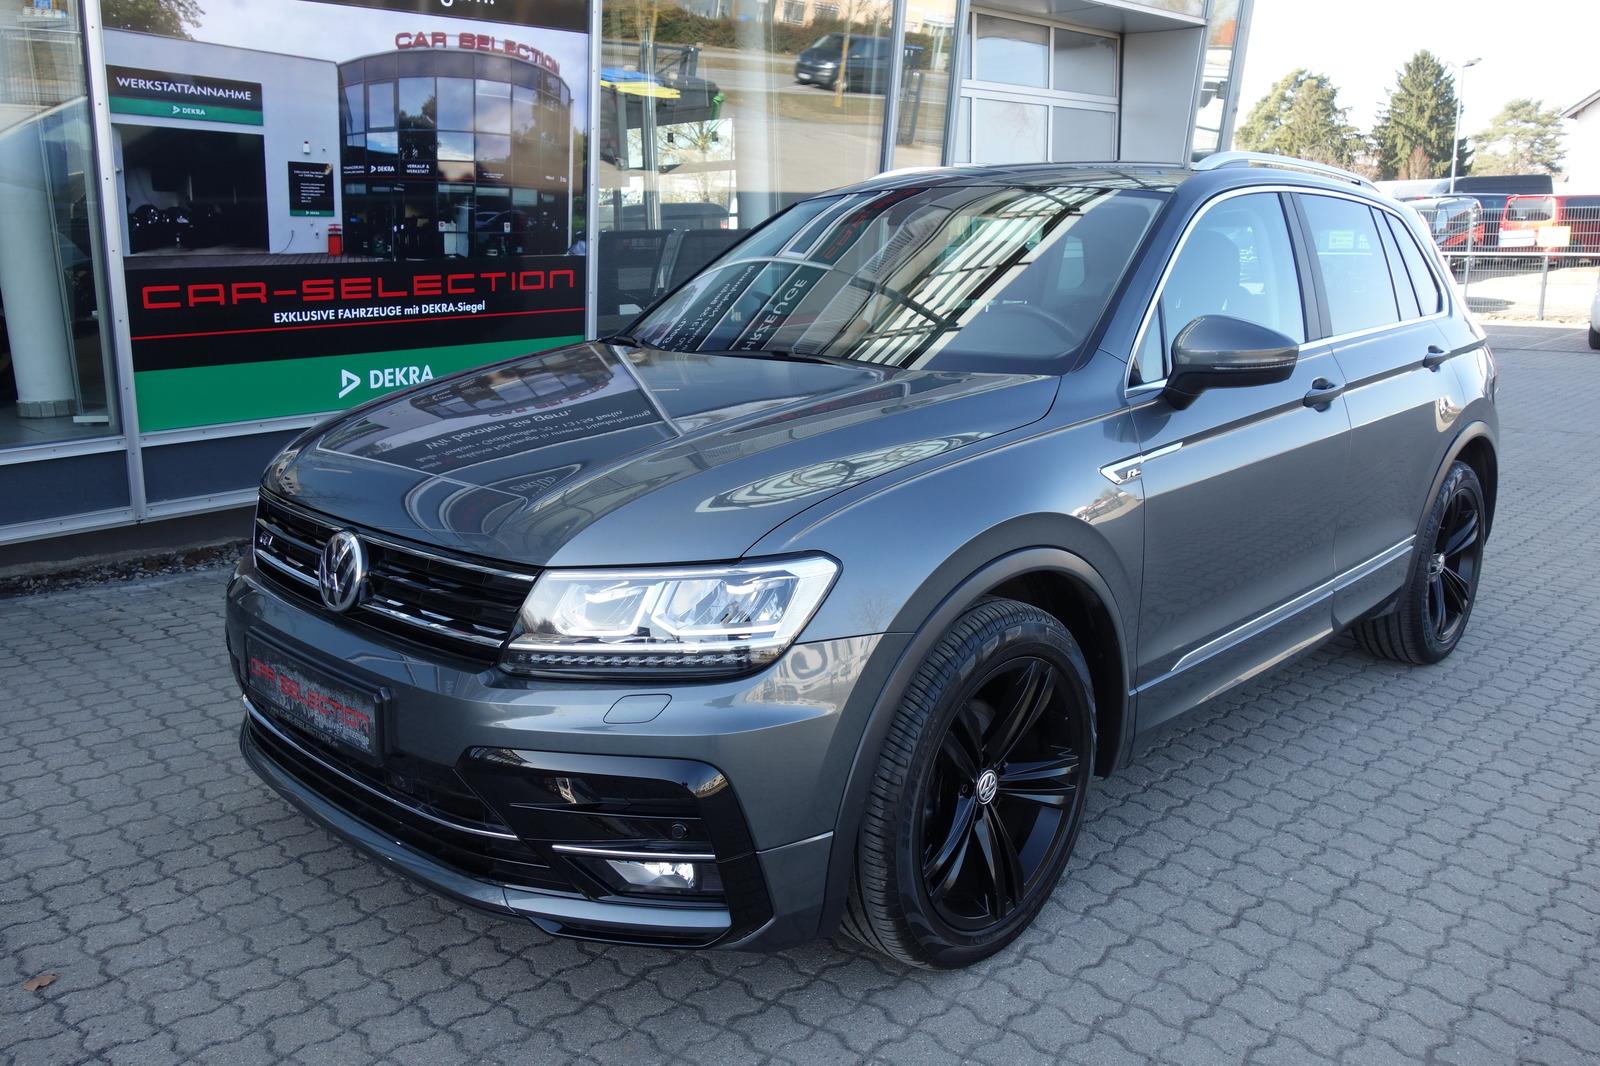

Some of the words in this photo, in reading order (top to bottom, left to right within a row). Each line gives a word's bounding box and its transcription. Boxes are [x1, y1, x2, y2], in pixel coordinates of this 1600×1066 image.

[395, 32, 447, 50] CAR
[116, 76, 252, 101] WERKSTATTANNAHME
[182, 107, 206, 116] DEKRA
[142, 269, 574, 309] CAR-SELECTION
[274, 309, 335, 324] EXKLUSIVE
[338, 305, 402, 319] FAHRZEUGE
[404, 304, 420, 315] mit
[421, 300, 486, 314] DEKRA-Siegel
[369, 364, 434, 389] DEKRA
